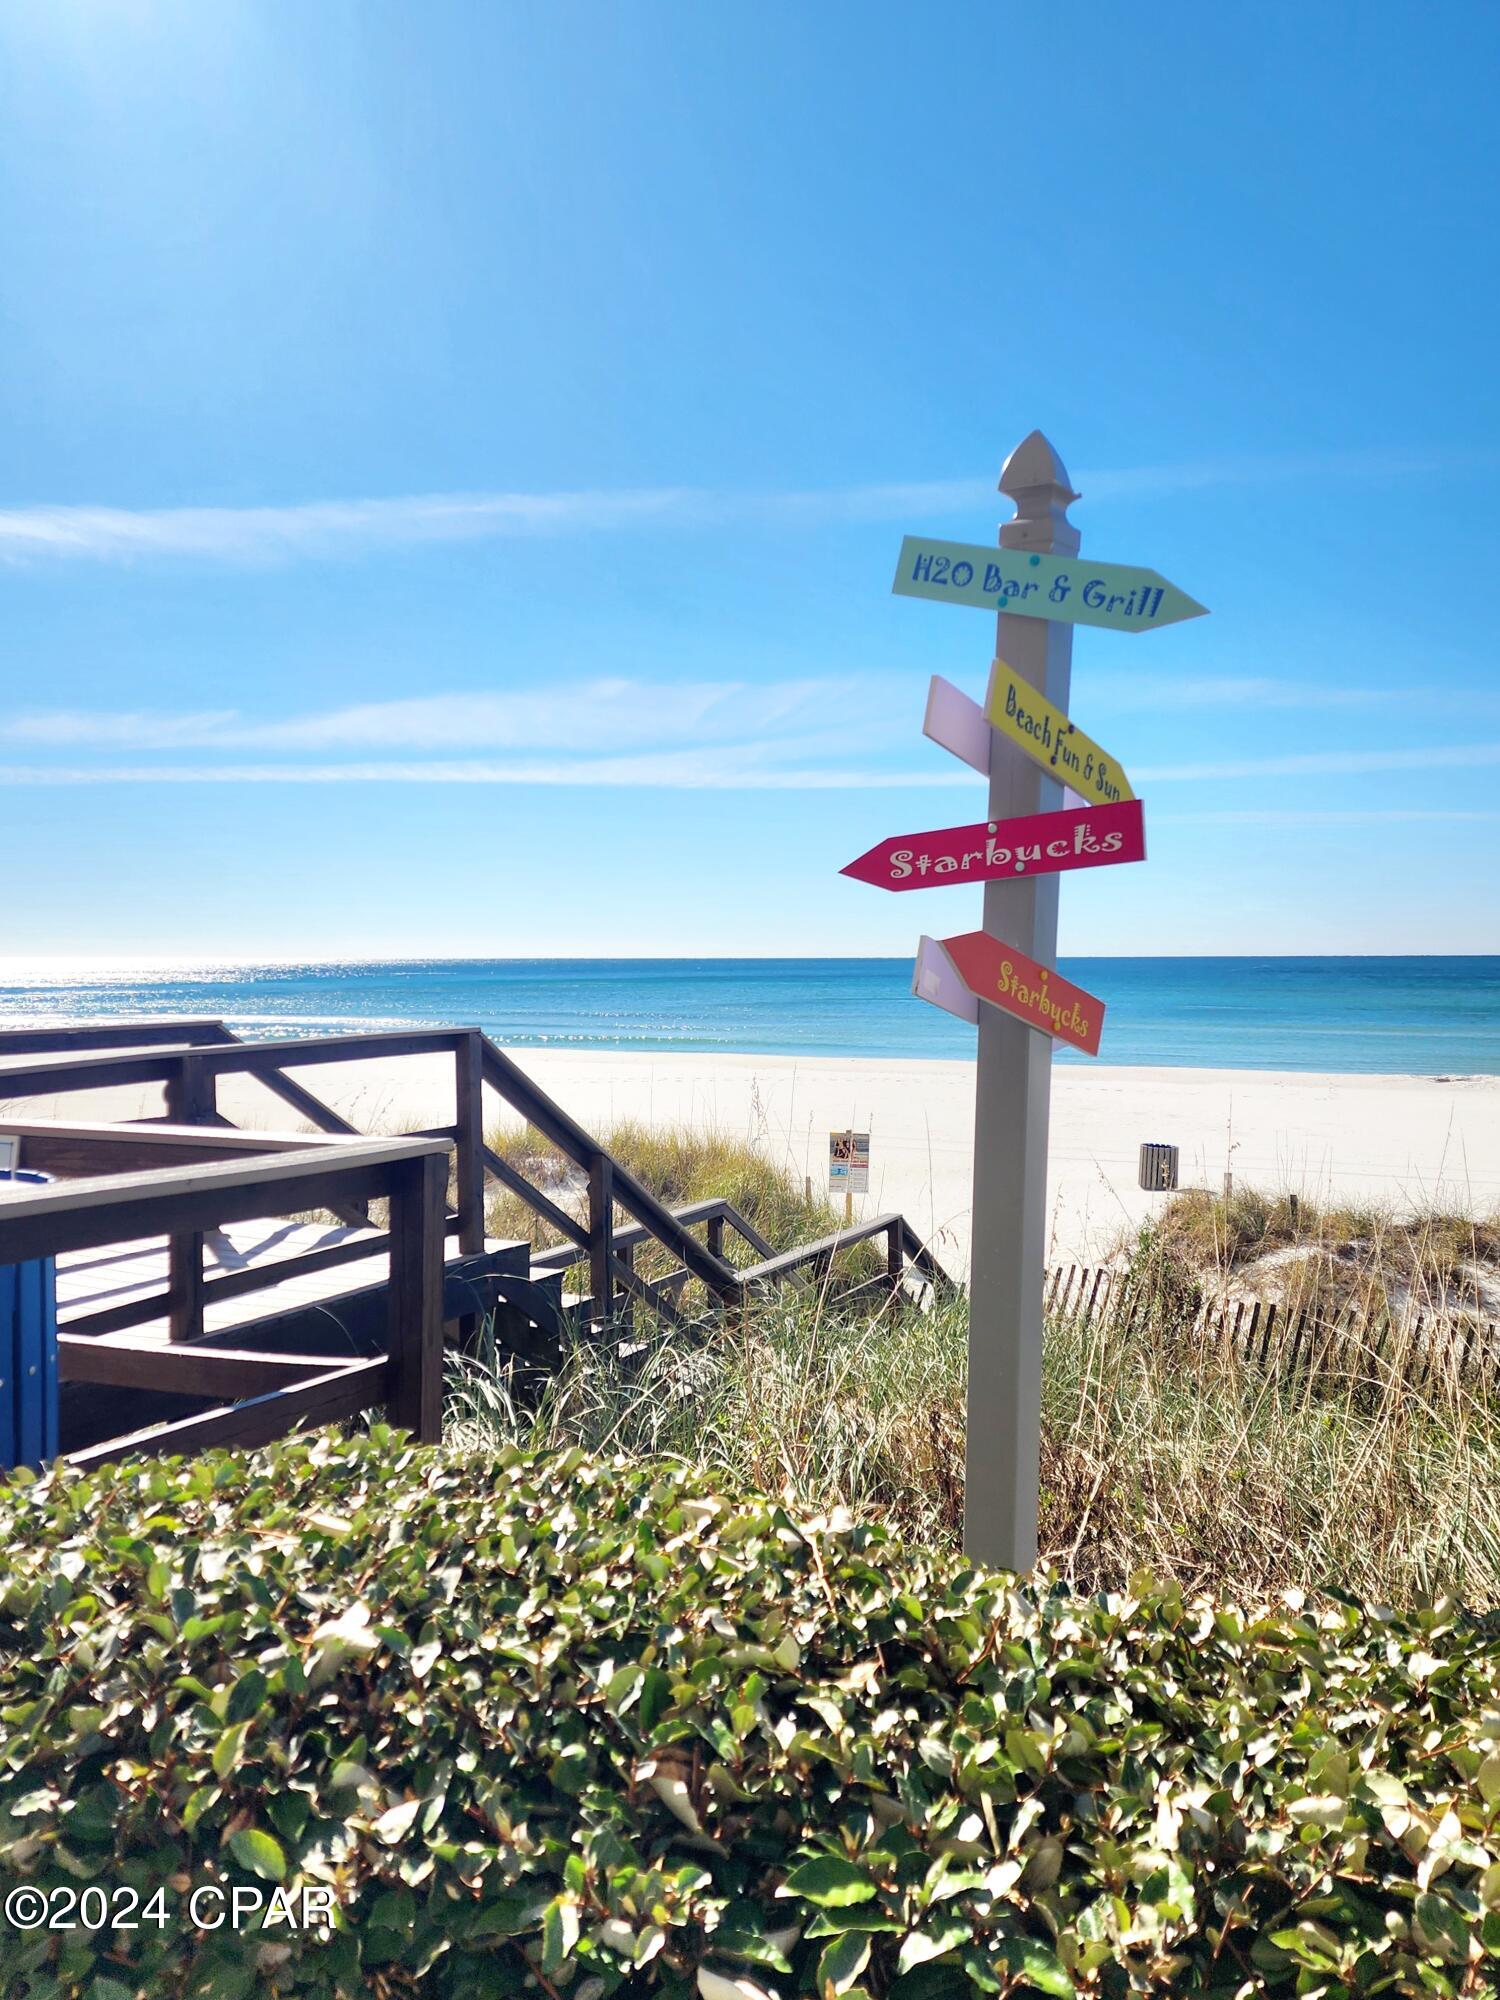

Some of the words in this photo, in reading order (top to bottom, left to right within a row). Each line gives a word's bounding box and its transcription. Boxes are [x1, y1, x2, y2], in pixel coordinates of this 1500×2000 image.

[912, 553, 974, 587] H2O
[983, 563, 1039, 600] Bar
[1049, 574, 1071, 602] &
[1083, 579, 1165, 618] Grill
[1004, 683, 1051, 748] Beach
[1054, 727, 1080, 772] Fun
[1083, 753, 1094, 781] &
[1095, 762, 1121, 801] Sun
[889, 823, 1124, 879] Starbucks
[997, 960, 1089, 1038] Starbucks
